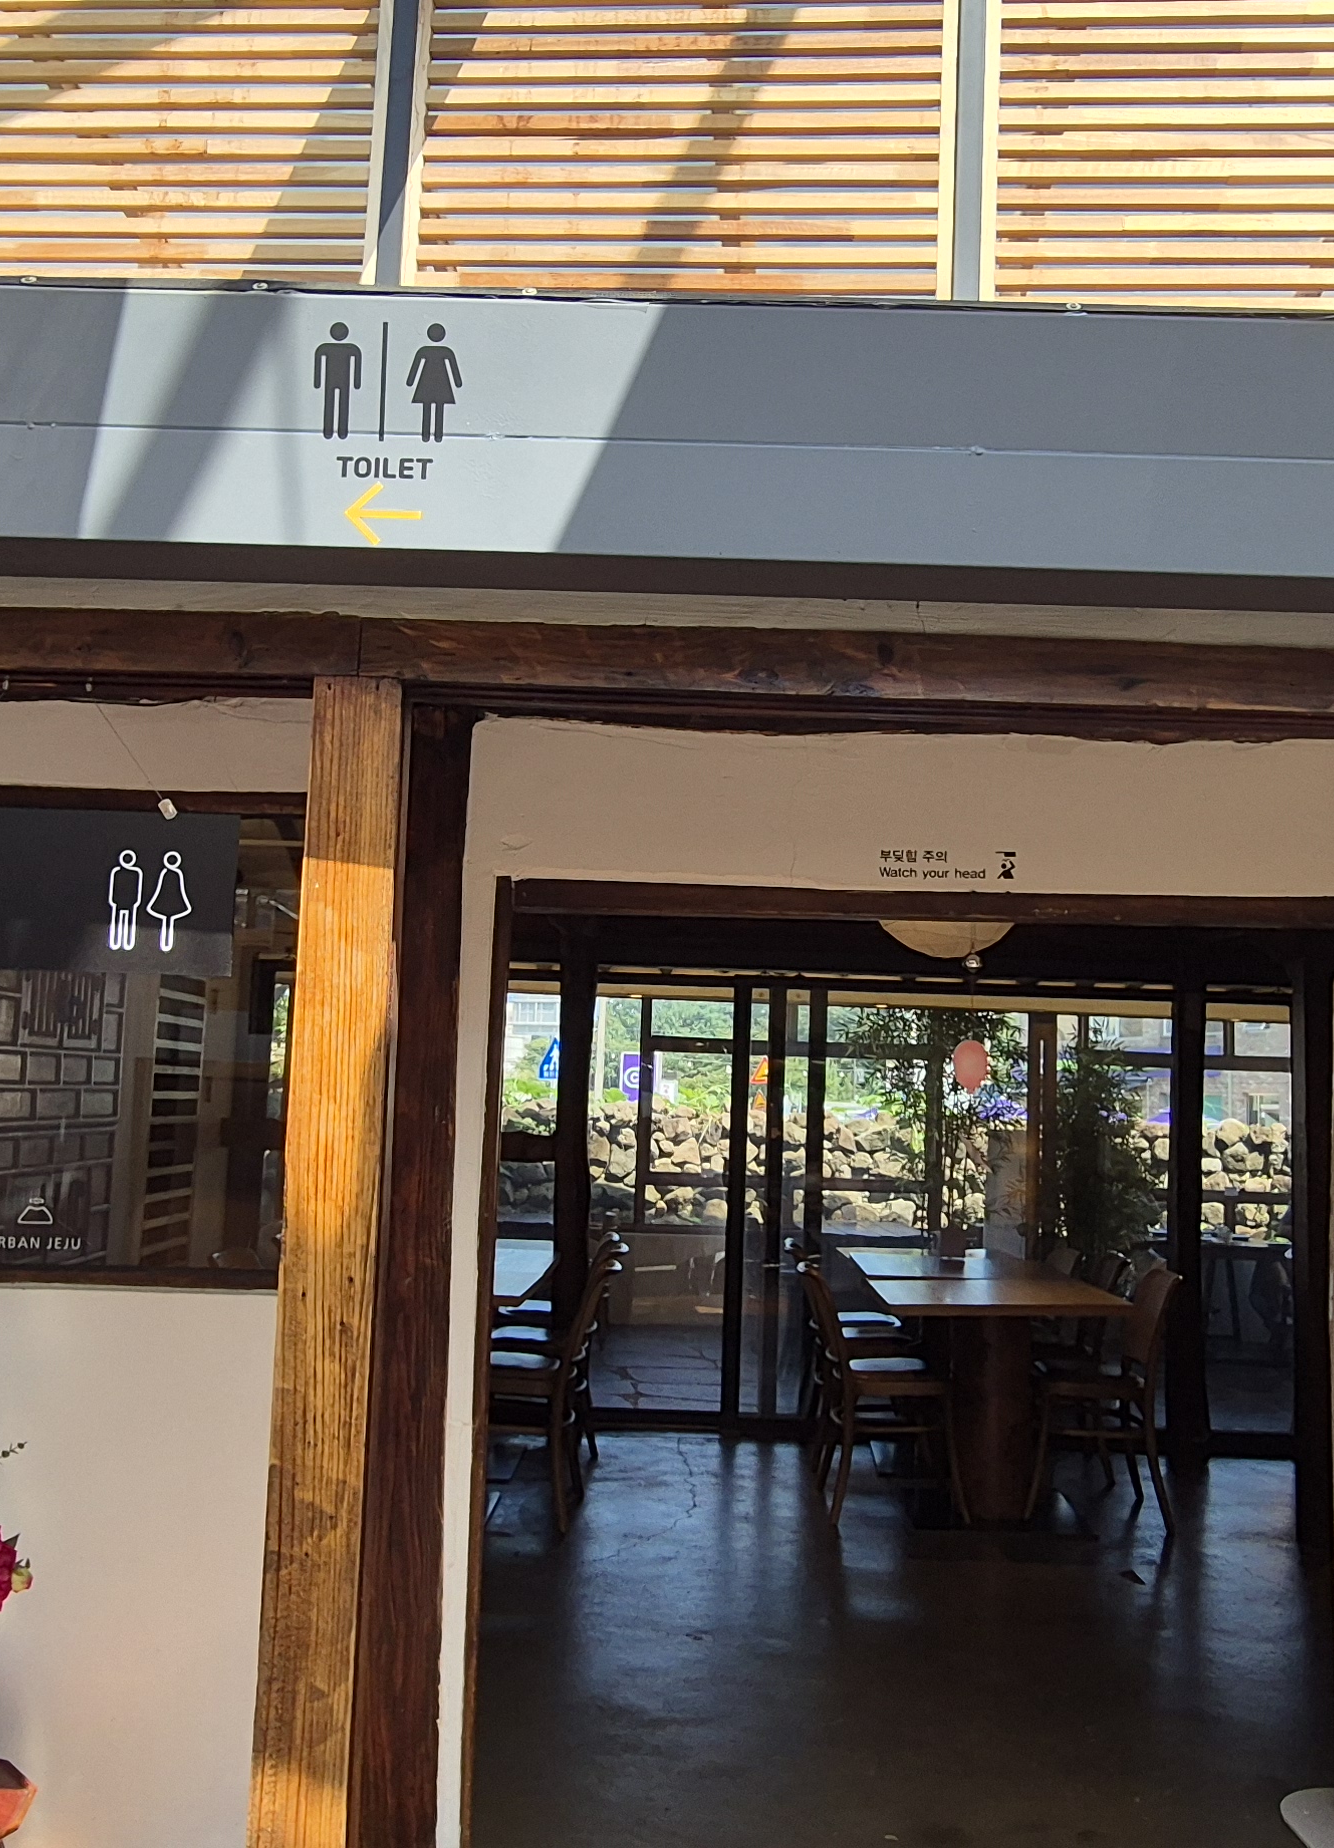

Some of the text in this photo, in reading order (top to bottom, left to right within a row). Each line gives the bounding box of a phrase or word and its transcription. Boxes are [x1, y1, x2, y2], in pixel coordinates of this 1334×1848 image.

[336, 456, 434, 480] TOILET
[922, 850, 948, 864] 주의
[879, 866, 986, 880] Watch your head
[46, 1237, 81, 1250] JEJU
